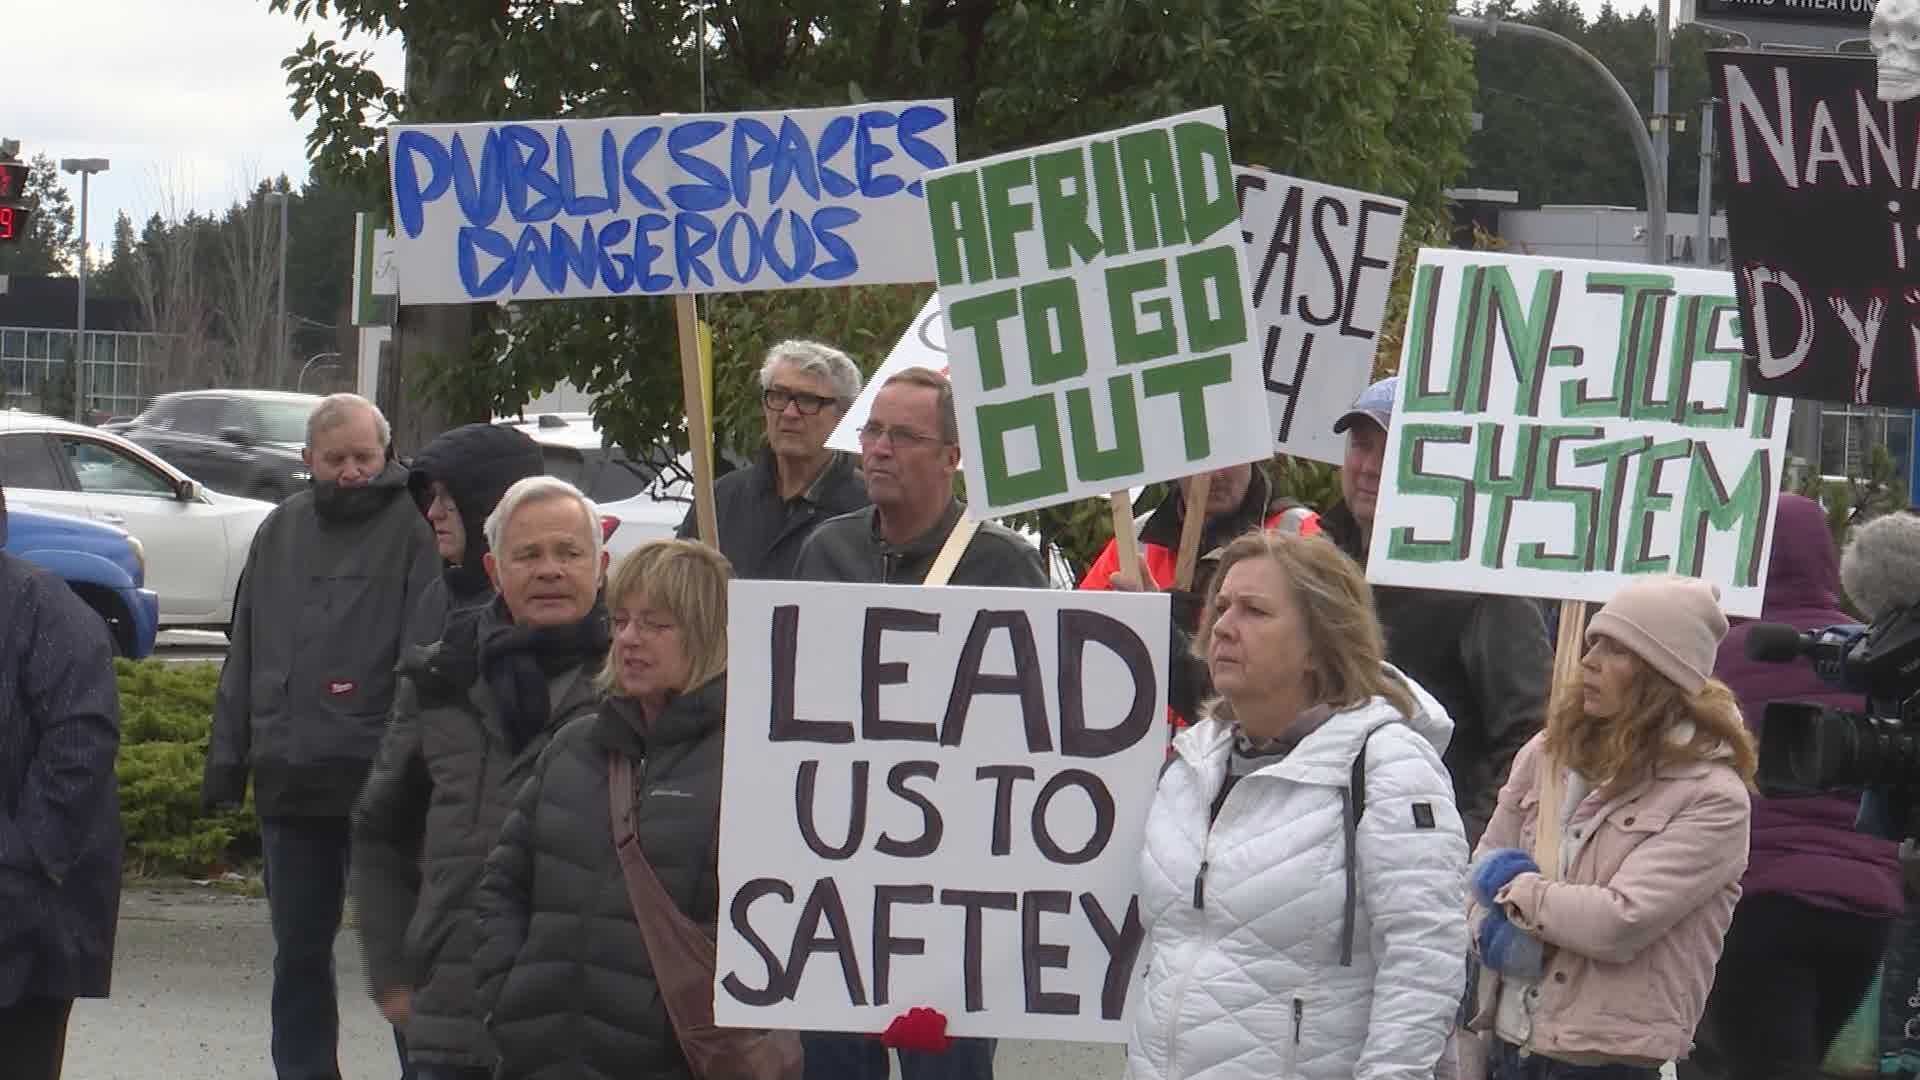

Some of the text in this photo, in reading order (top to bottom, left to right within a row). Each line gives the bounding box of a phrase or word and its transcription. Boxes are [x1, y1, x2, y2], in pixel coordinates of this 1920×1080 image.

[458, 207, 862, 298] DANGEROUS
[924, 121, 1241, 287] AFRIAD
[949, 244, 1248, 392] TO GO
[975, 353, 1232, 508] OUT
[1386, 423, 1771, 588] SYSTEM
[769, 604, 1157, 758] LEAD
[795, 760, 1115, 865] US TO
[721, 876, 1145, 1020] SAFTEY
